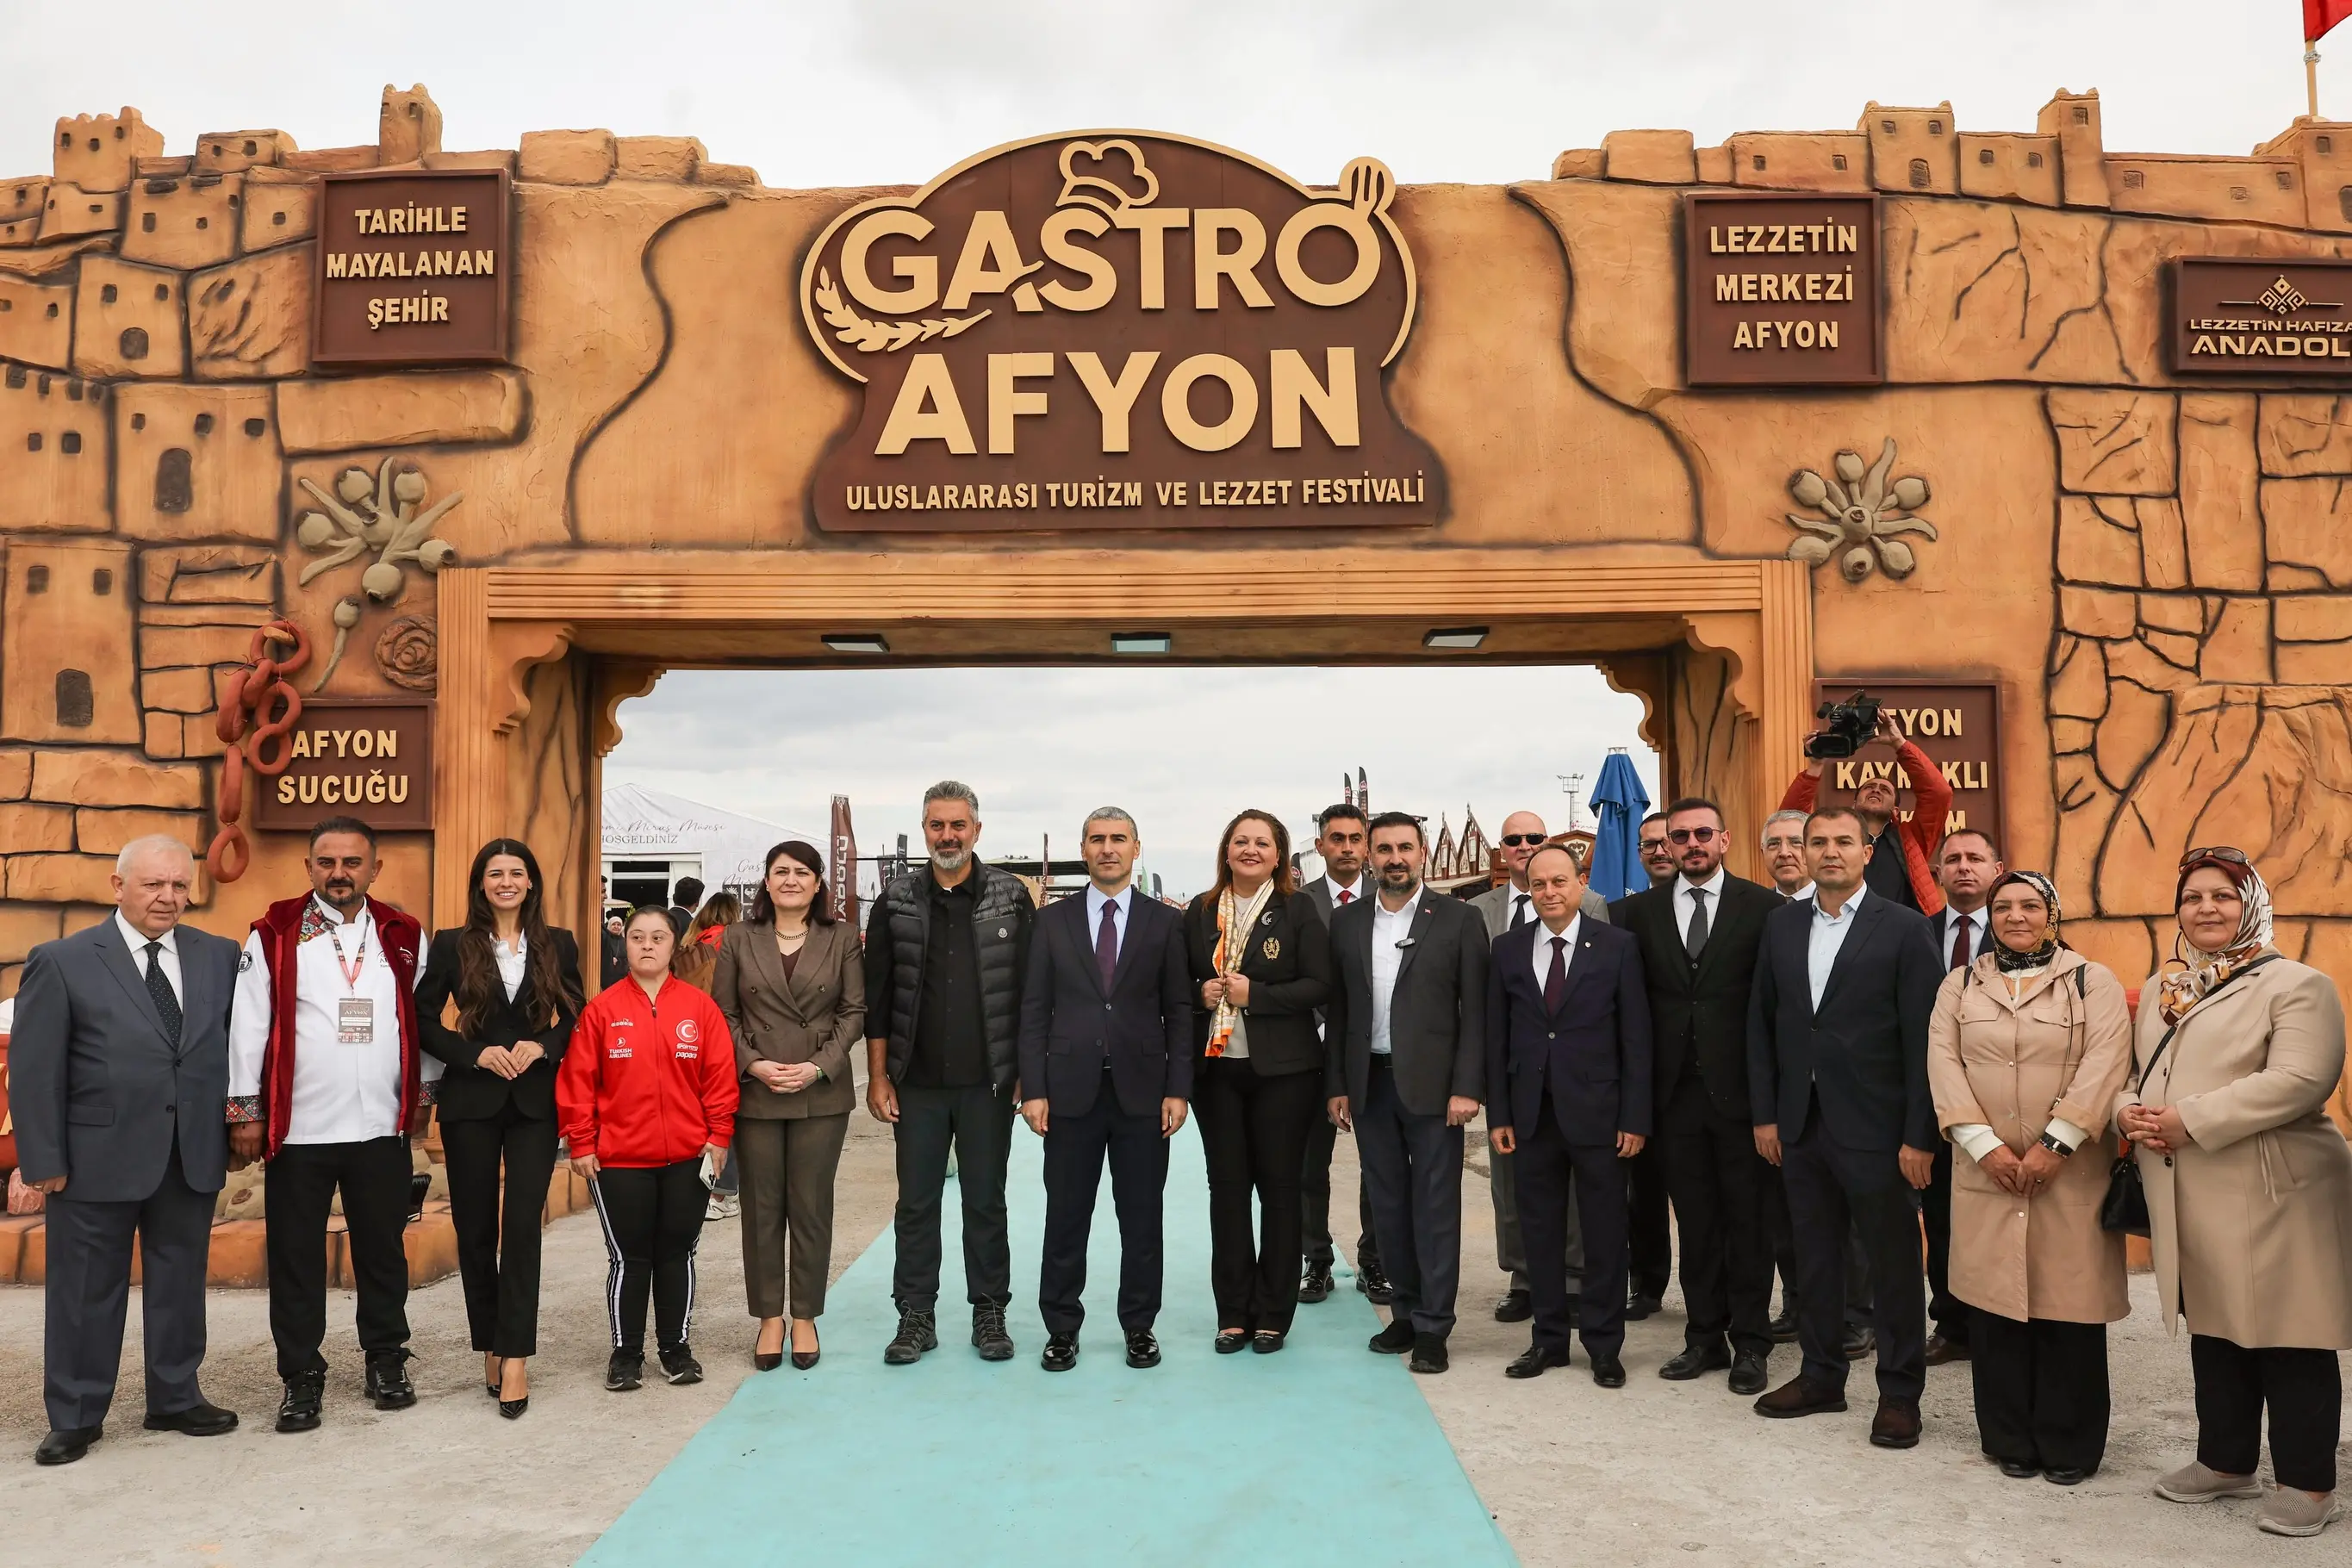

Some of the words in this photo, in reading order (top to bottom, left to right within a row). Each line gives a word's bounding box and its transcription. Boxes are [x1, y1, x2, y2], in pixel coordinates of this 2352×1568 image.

[355, 201, 467, 234] TARİHLE
[1710, 215, 1857, 254] LEZZETİN
[327, 250, 495, 278] MAYALANAN
[840, 202, 1381, 314] GASTRO
[1715, 264, 1854, 302] MERKEZİ
[368, 289, 449, 330] ŞEHİR
[1733, 320, 1839, 349] AFYON
[2191, 335, 2351, 358] ANADOL
[874, 346, 1360, 455] AFYON
[846, 482, 1037, 510] ULUSLARARASI
[1046, 475, 1142, 507] TURİZM
[1155, 482, 1187, 507] VE
[1199, 480, 1293, 507] LEZZET
[1303, 470, 1426, 505] FESTİVALİ
[1874, 707, 1963, 737] YON
[291, 730, 397, 758] AFYON
[277, 768, 408, 804] SUCUĞU
[836, 835, 849, 923] ADOLU
[675, 1051, 698, 1060] papara
